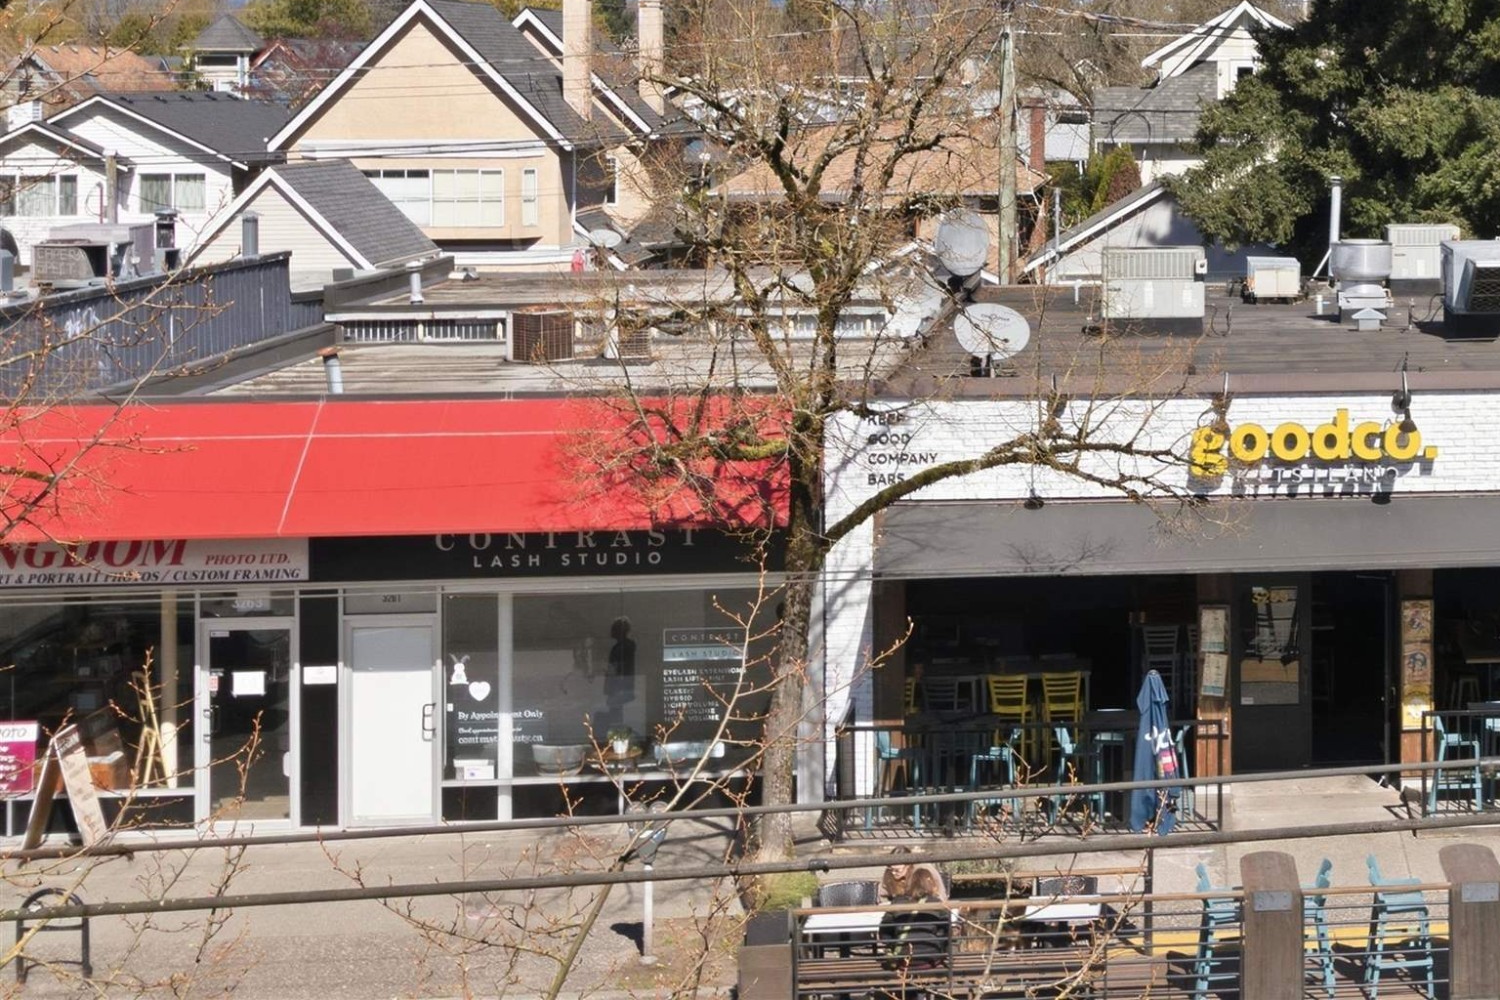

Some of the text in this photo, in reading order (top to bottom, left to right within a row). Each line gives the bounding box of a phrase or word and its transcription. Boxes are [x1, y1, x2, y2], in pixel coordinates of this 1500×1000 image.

[868, 433, 911, 445] GOOD
[1189, 408, 1439, 477] goodco.
[868, 452, 938, 465] COMPANY
[434, 528, 699, 551] CONTRAST
[204, 553, 257, 565] PHOTO
[259, 552, 291, 565] LTD.
[473, 551, 662, 568] LASH STUDIO
[27, 571, 101, 584] PORTRAIT
[103, 570, 160, 583] PHOS
[173, 569, 233, 582] CUSTOM
[234, 568, 300, 581] FRAMING
